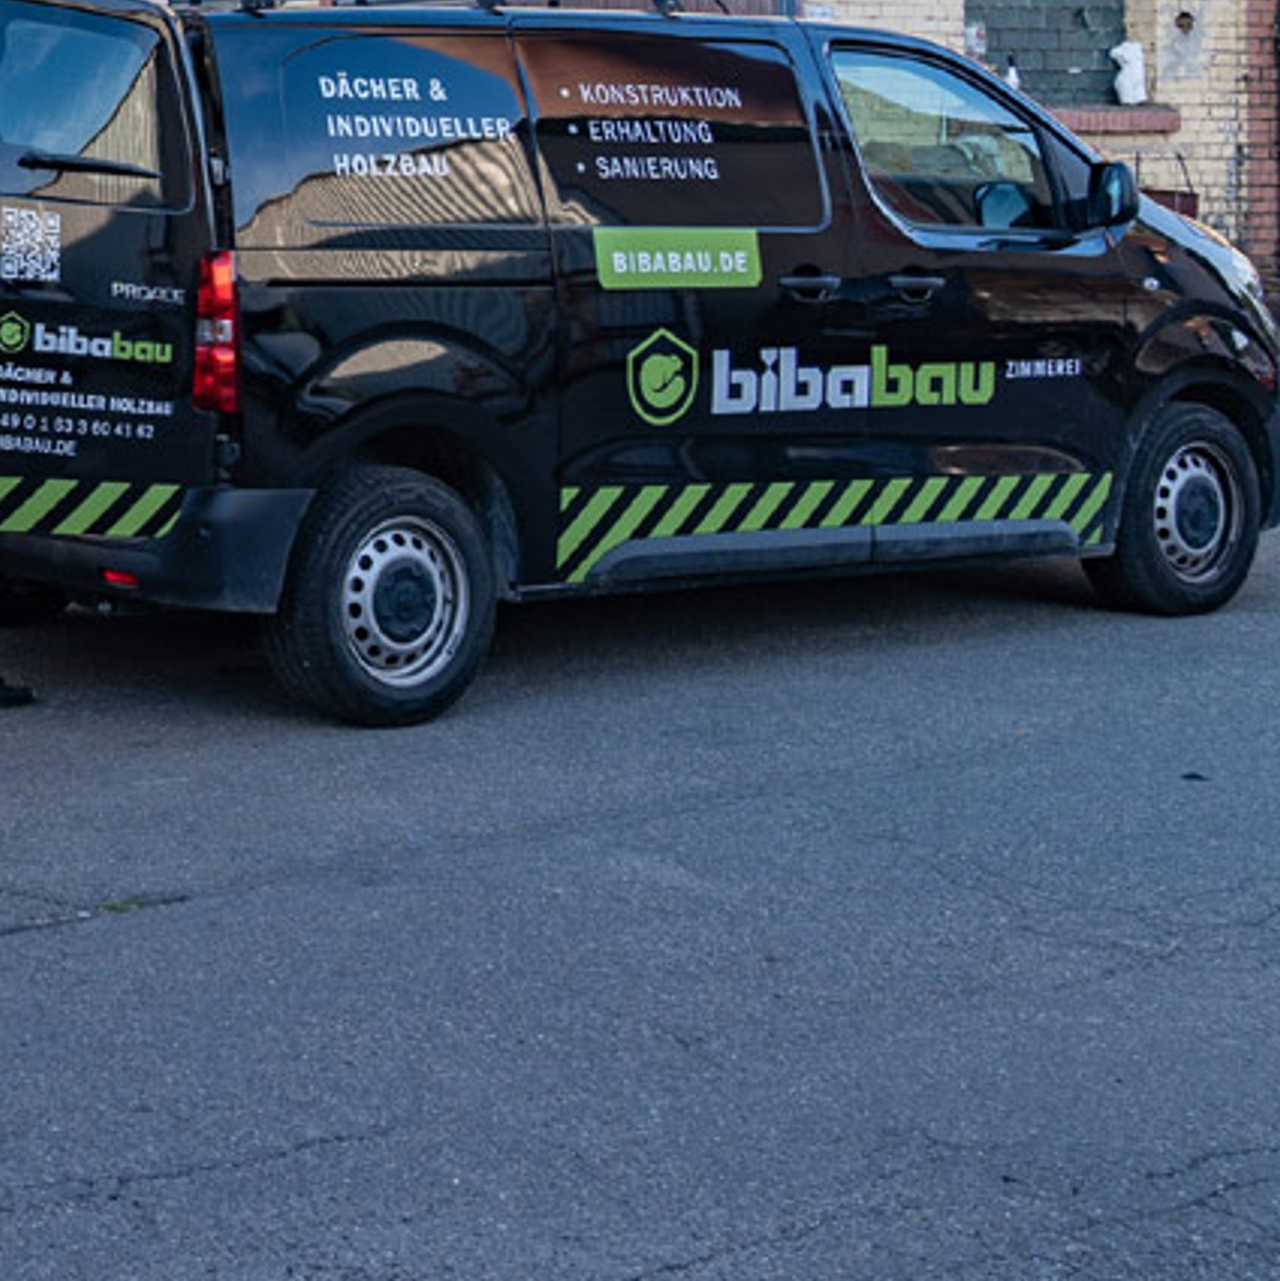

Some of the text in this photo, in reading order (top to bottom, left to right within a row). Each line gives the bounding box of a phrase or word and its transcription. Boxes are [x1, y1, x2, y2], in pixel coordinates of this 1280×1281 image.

[318, 71, 448, 101] DÄCHER &
[578, 83, 742, 108] KONSTRUKTION
[327, 115, 516, 143] INDIVIDUELLER
[589, 120, 714, 143] ERHALTUNG
[333, 153, 451, 177] HOLZBAU
[596, 156, 719, 179] SANIERUNG
[611, 250, 748, 273] BIBABAU.DE
[34, 322, 173, 363] bibabau
[59, 370, 73, 385] &
[711, 344, 1082, 414] bibabau ZIMMEREI
[110, 397, 175, 416] HOLZBAU
